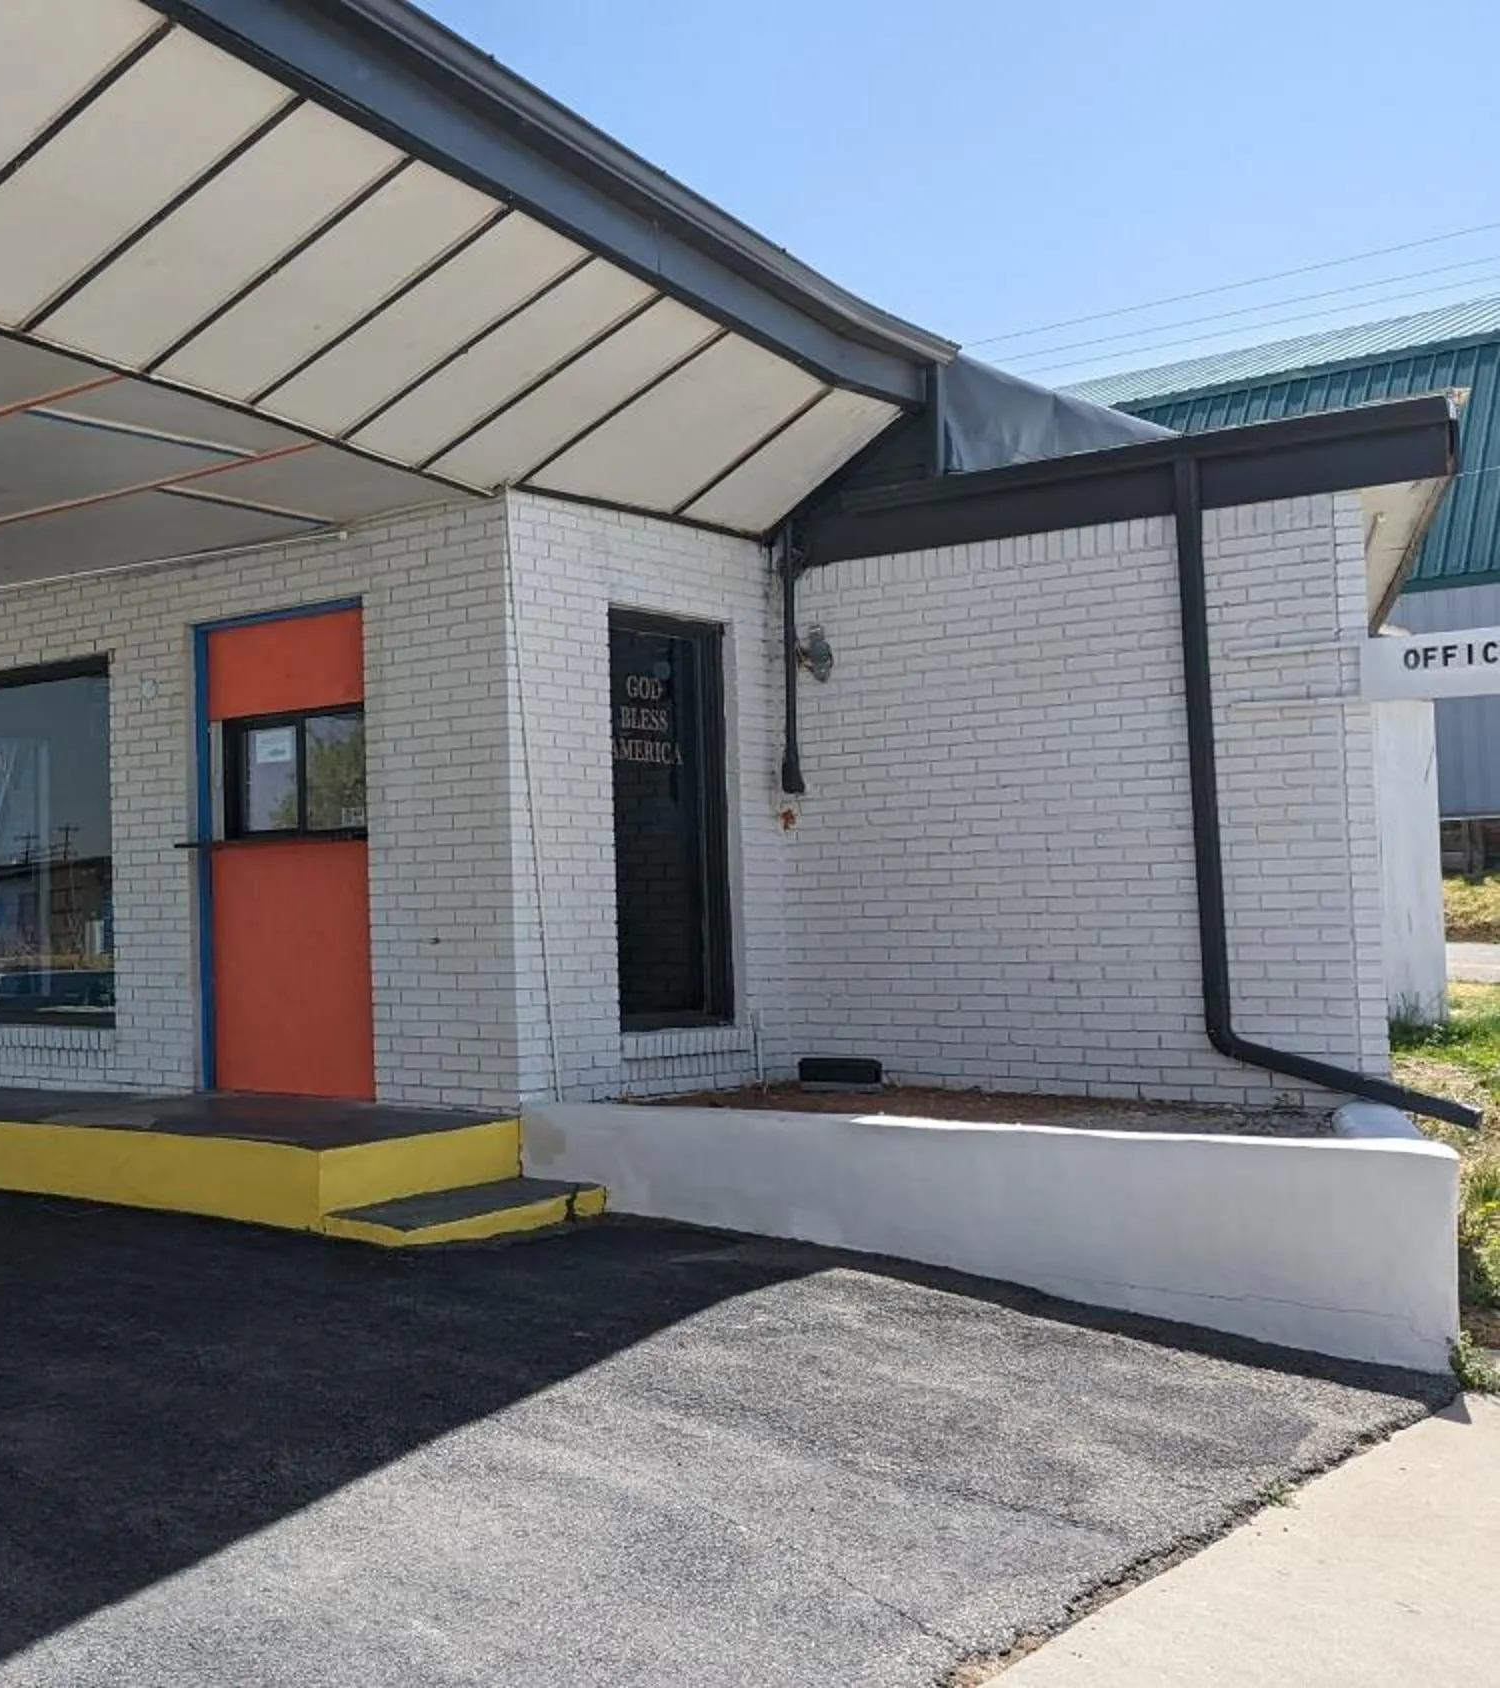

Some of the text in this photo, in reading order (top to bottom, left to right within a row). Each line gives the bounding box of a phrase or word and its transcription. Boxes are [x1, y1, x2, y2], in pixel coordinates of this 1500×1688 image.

[1403, 641, 1499, 670] OFFIC
[626, 675, 663, 699] GOD
[620, 706, 668, 731] BLESS
[612, 738, 684, 765] AMERICA
